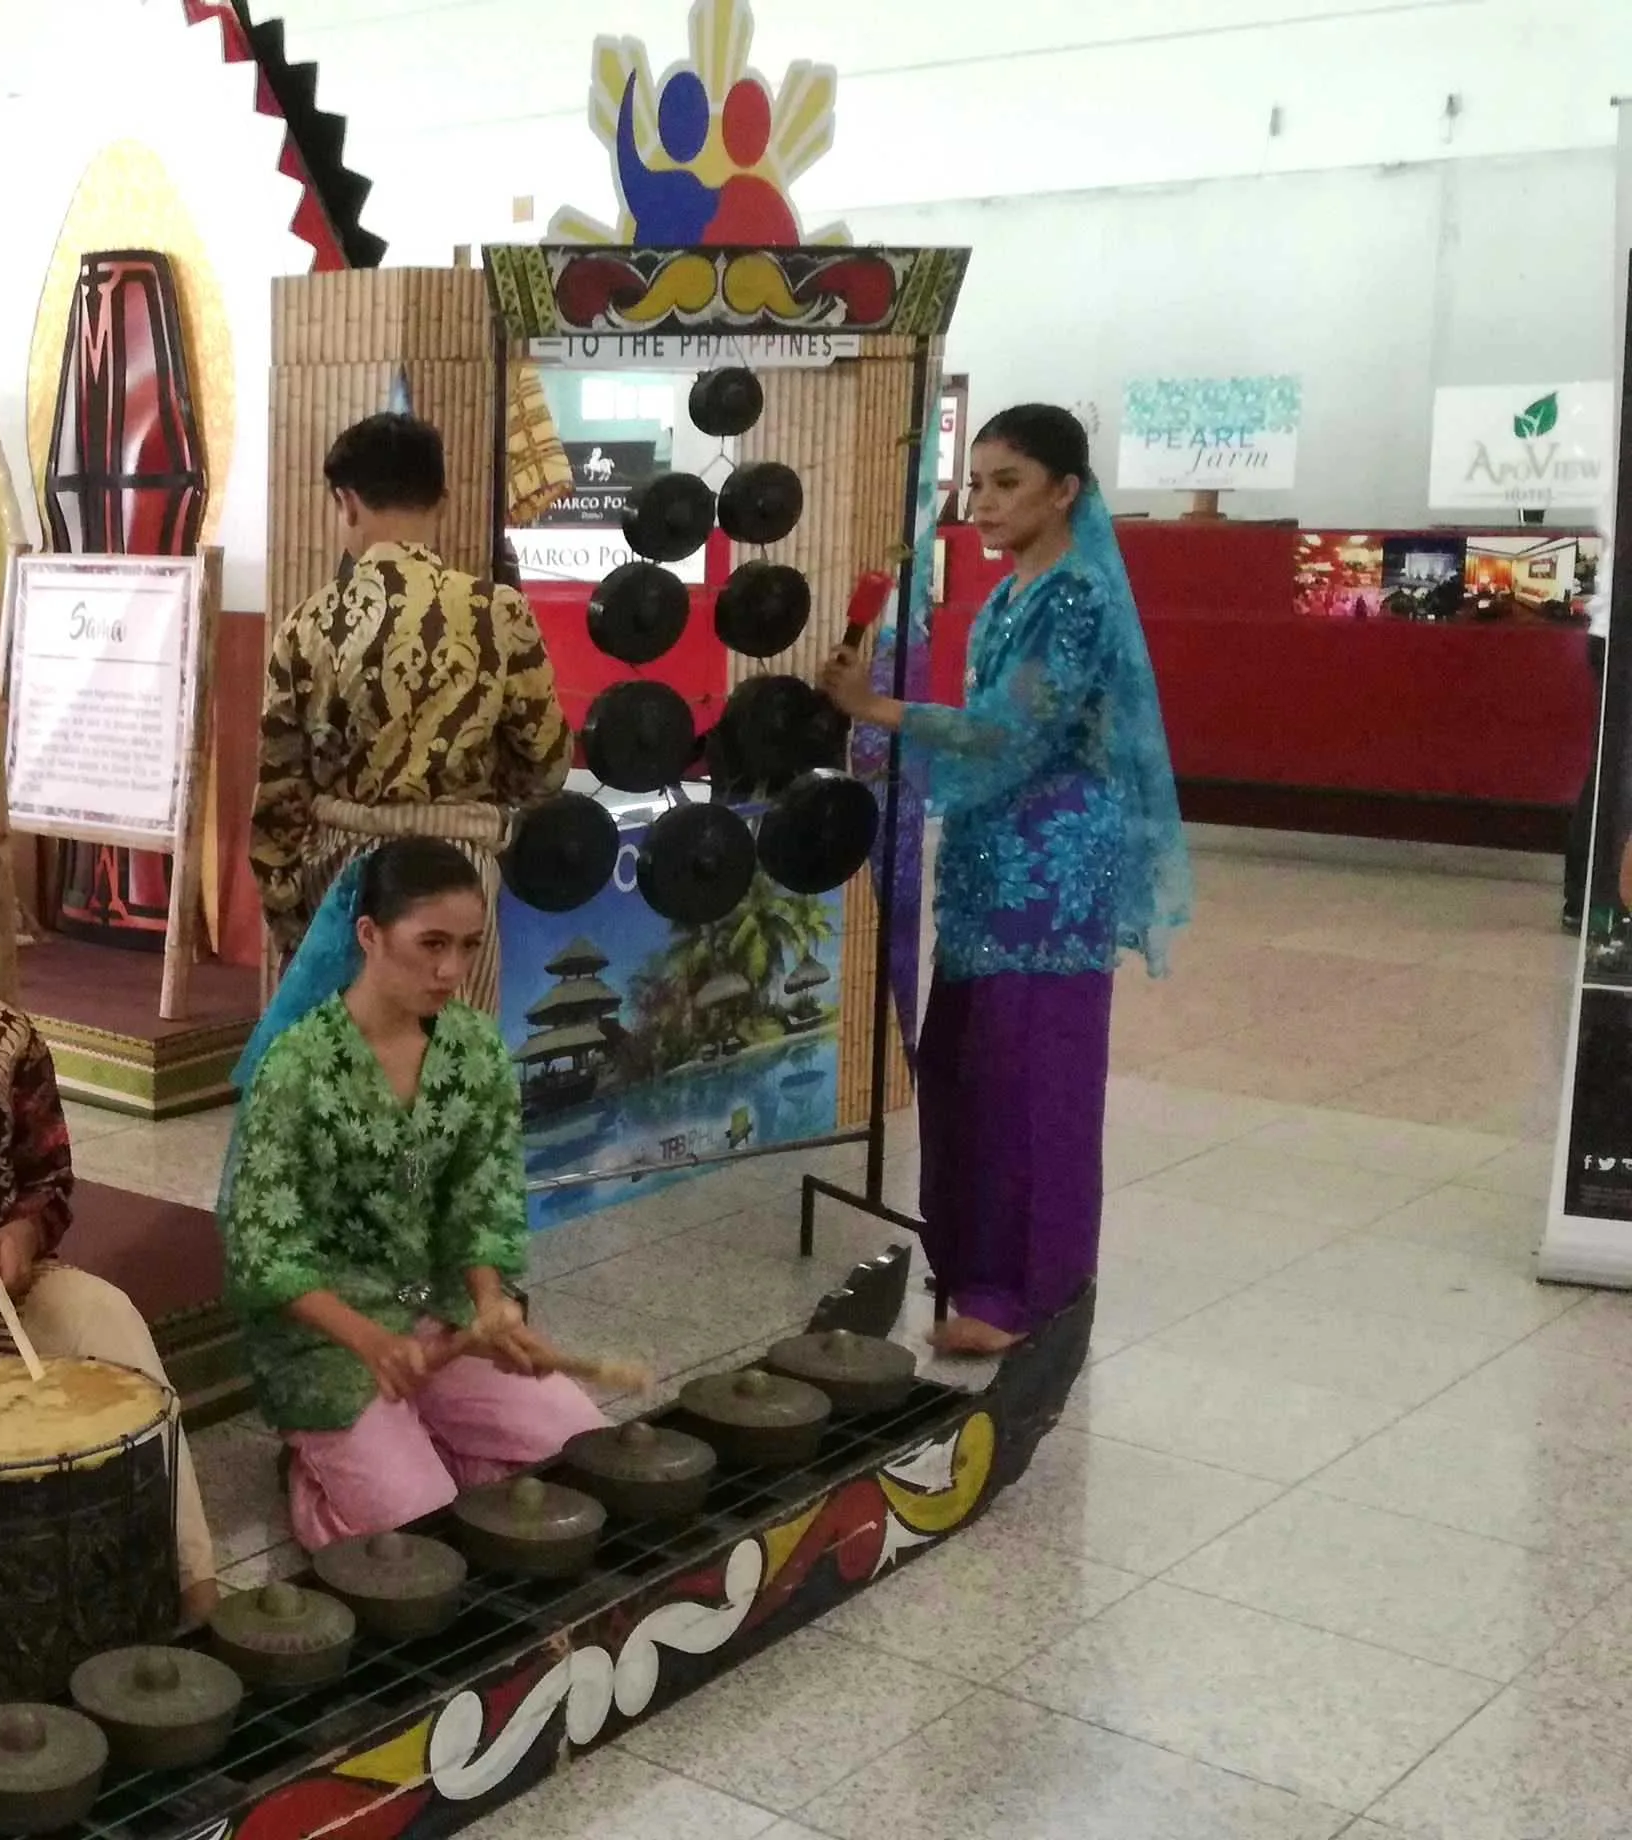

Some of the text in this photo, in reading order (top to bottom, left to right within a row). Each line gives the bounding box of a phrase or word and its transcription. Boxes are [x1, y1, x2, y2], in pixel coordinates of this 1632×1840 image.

[567, 335, 832, 358] TO THE PHILIPPINES
[1145, 425, 1255, 449] PEARL
[550, 497, 599, 510] MARCO
[519, 546, 589, 567] MARCO
